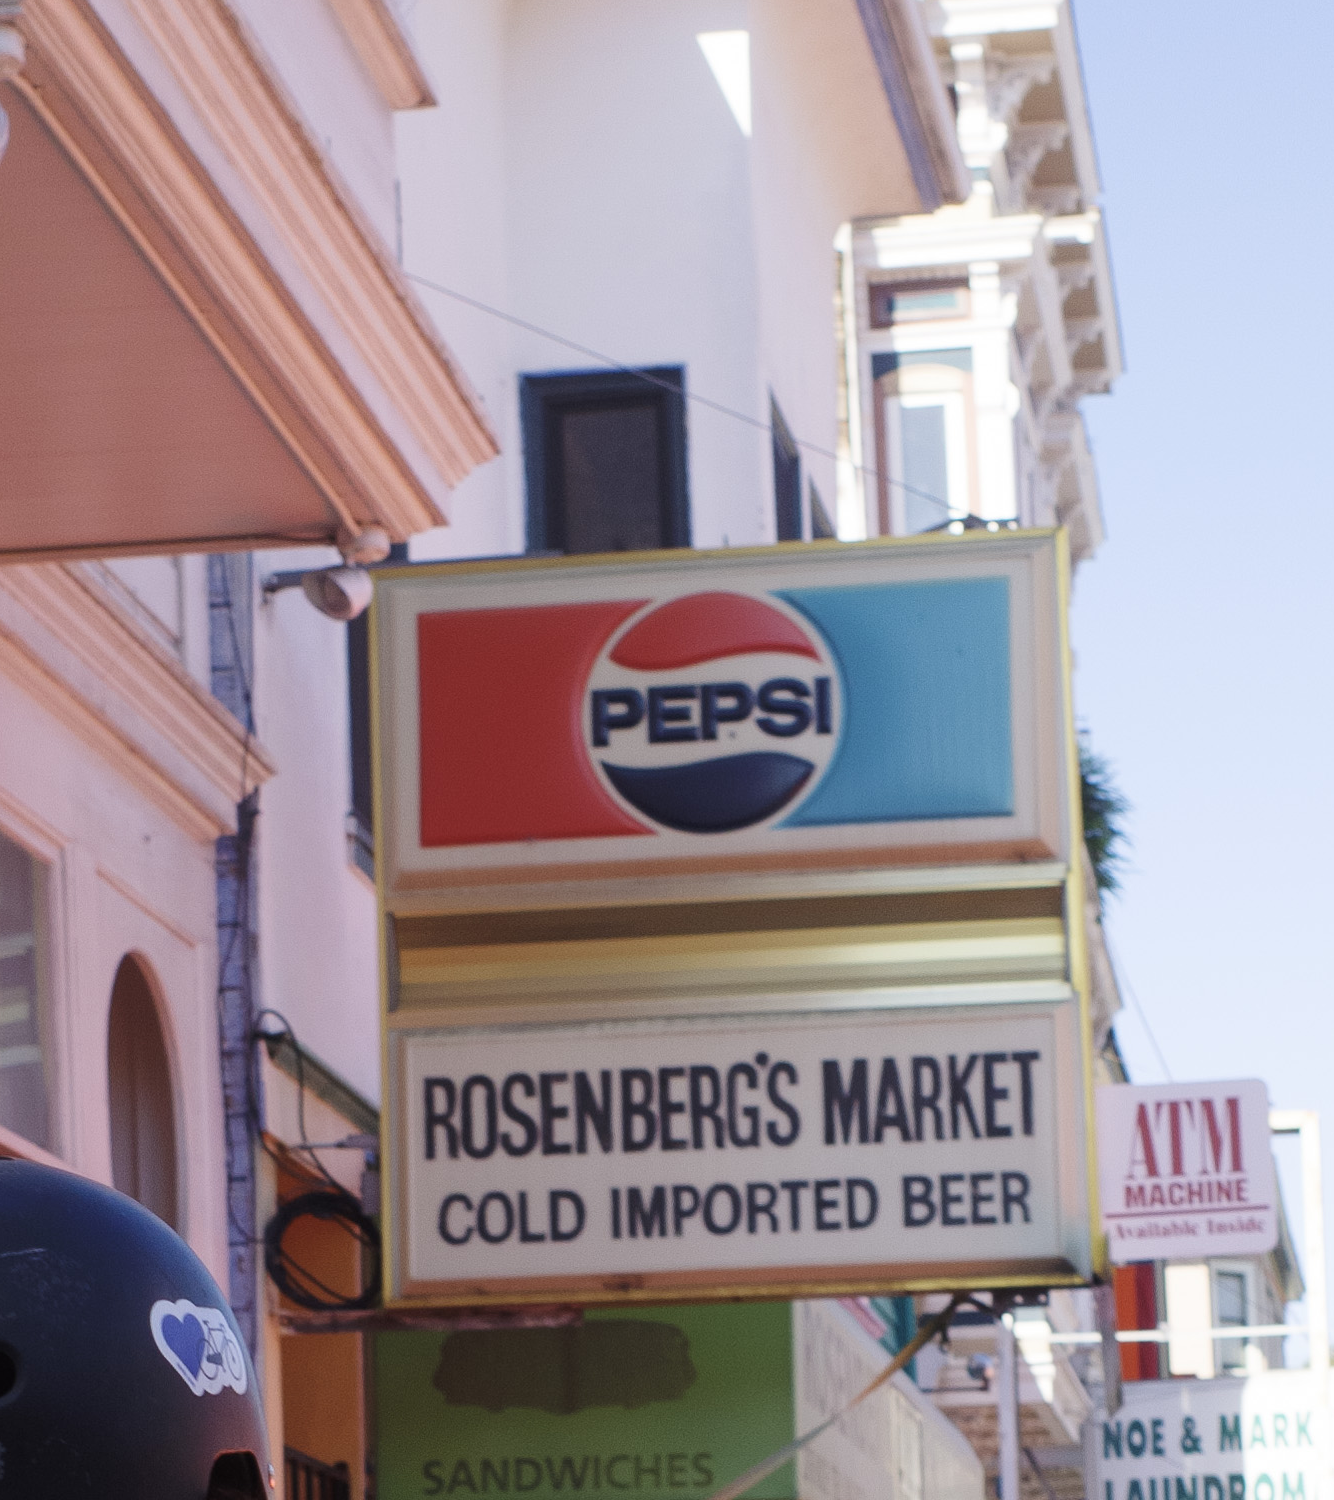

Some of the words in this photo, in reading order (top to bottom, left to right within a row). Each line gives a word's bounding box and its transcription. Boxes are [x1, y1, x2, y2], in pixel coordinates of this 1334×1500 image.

[591, 677, 833, 748] PEPSI
[422, 1052, 802, 1161] ROSENBERG'S
[822, 1051, 1041, 1146] MARKET
[1126, 1097, 1245, 1180] ATM
[438, 1188, 586, 1246] COLD
[610, 1179, 881, 1240] IMPORTED
[902, 1171, 1032, 1228] BEER
[1123, 1179, 1249, 1208] MACHINE
[1115, 1220, 1199, 1240] Available
[1206, 1216, 1265, 1236] Inside
[1101, 1415, 1165, 1460] NOE
[1180, 1415, 1203, 1454] &
[422, 1452, 716, 1496] SANDWICHES
